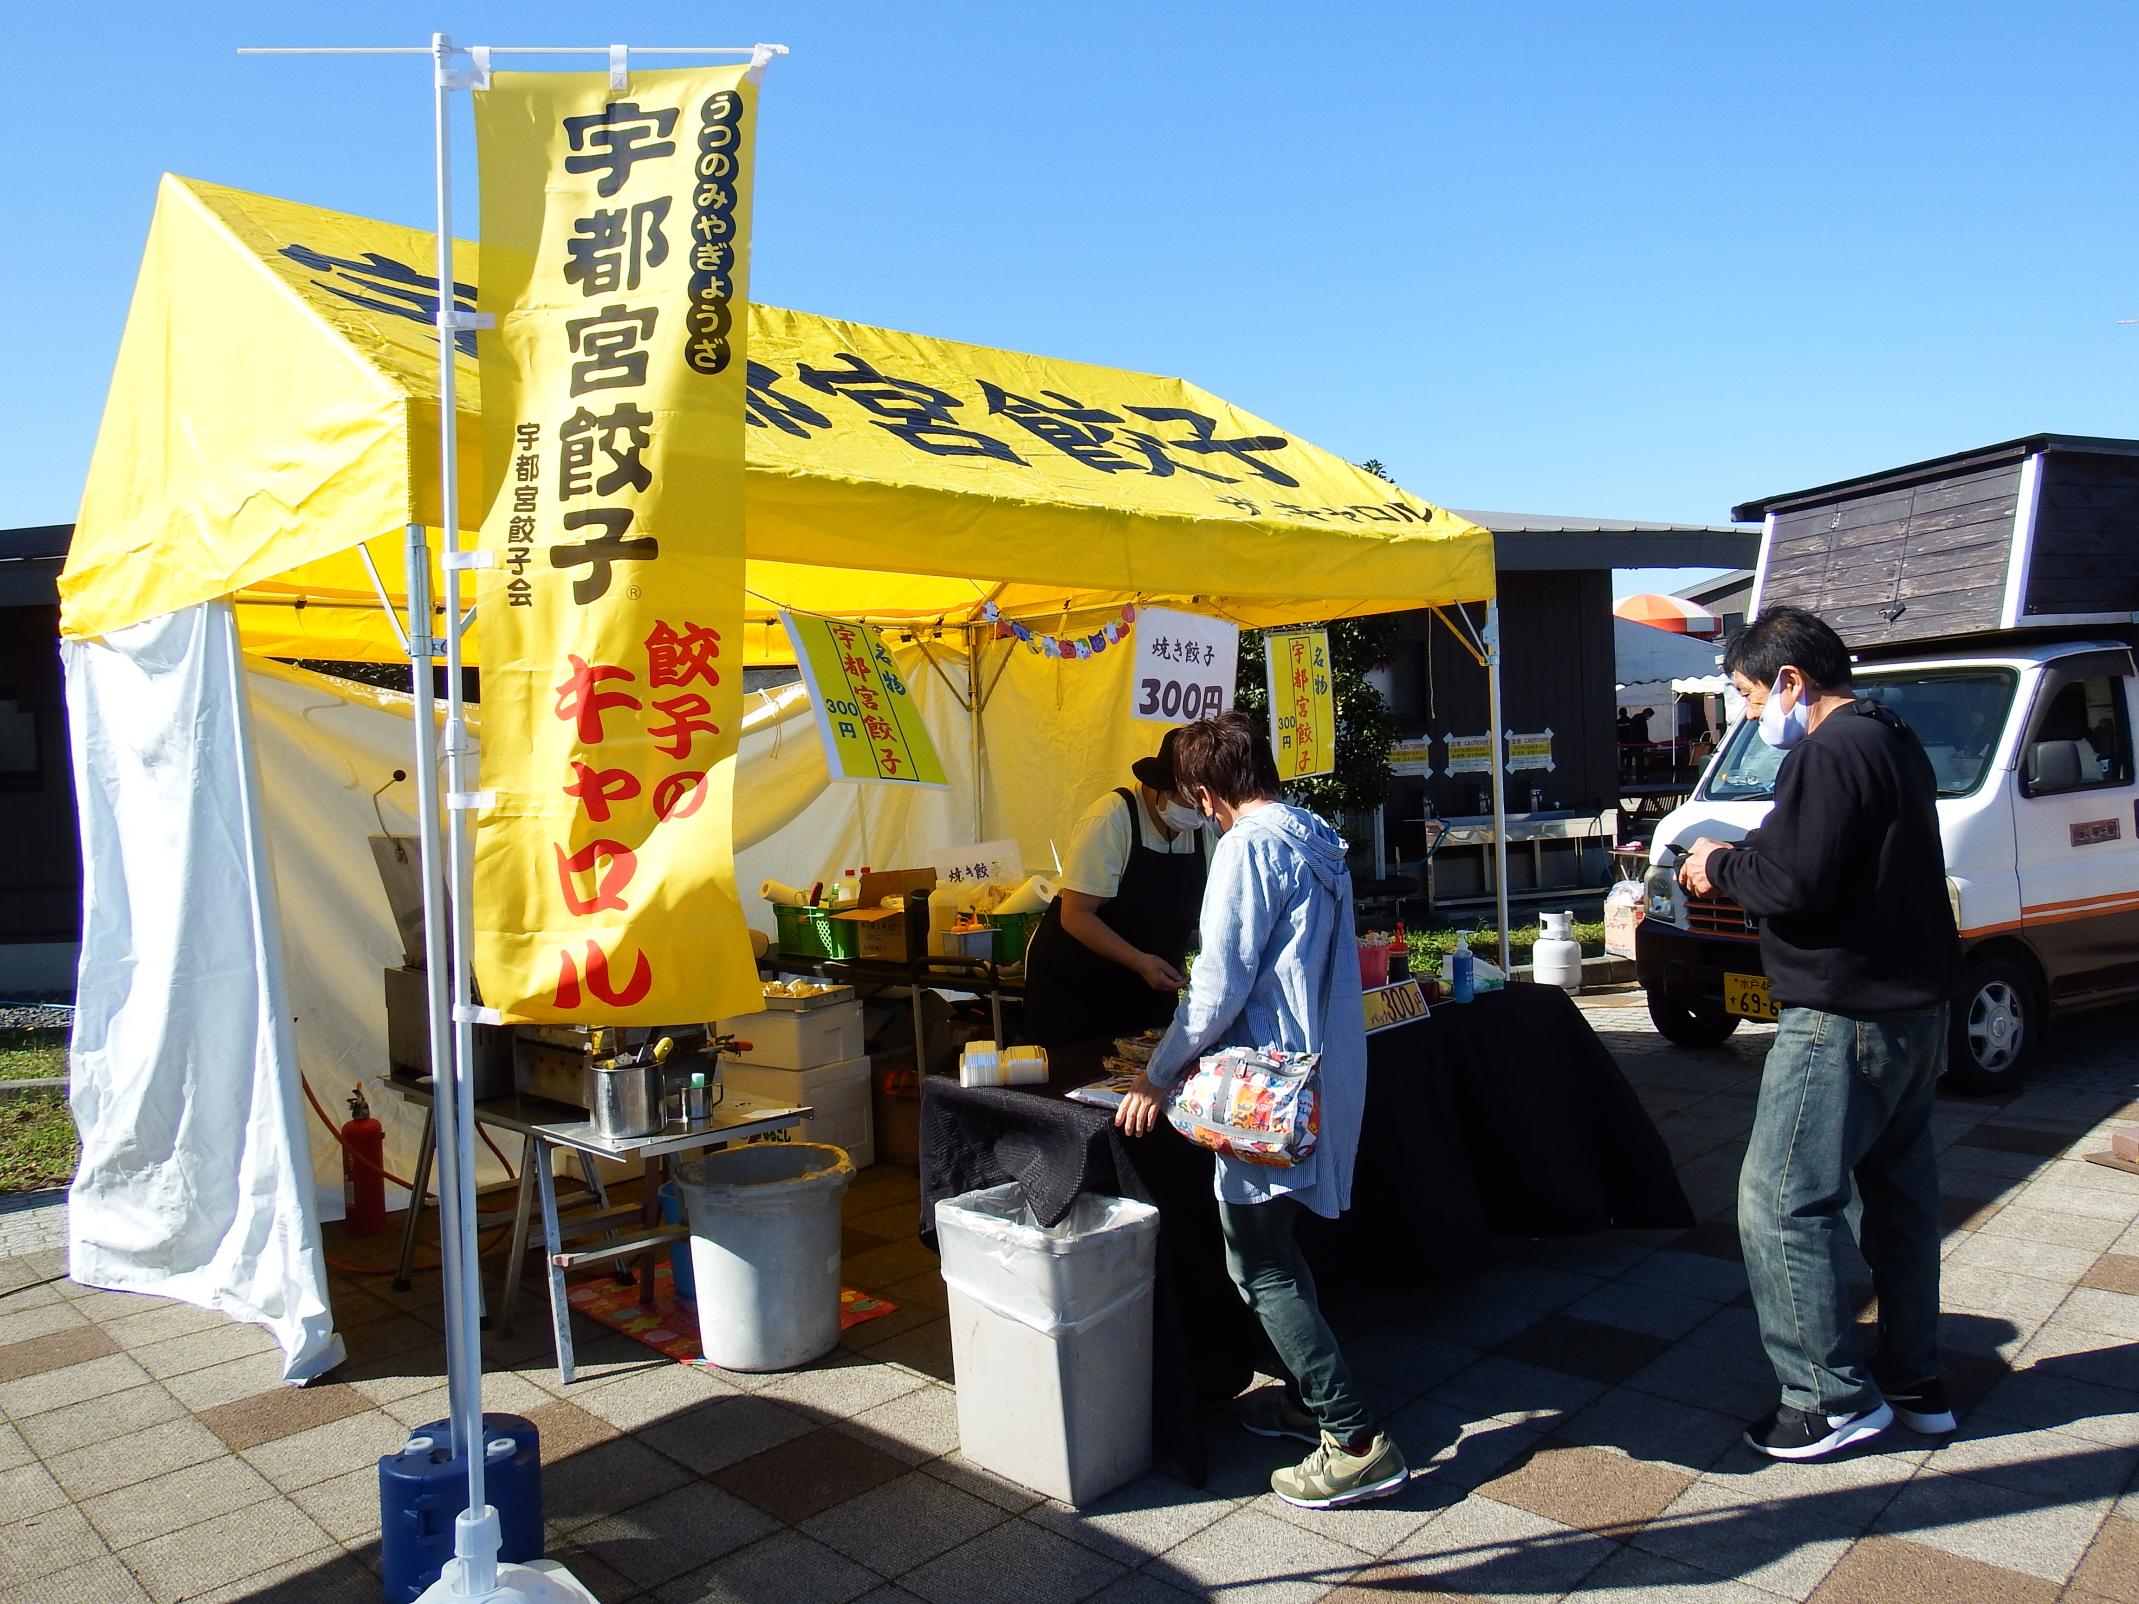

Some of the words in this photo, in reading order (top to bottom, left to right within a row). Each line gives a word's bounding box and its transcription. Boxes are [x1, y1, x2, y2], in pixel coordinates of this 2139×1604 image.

[692, 93, 734, 370] うつのみやぎょうざ
[550, 102, 680, 606] 宇都宮餃子
[506, 421, 541, 608] 宇都宮餃子会
[643, 619, 722, 823] 餃子の
[832, 625, 902, 775] 宇都宮餃子
[875, 643, 907, 696] 名物
[1138, 678, 1223, 721] 300円
[1151, 636, 1215, 667] 焼き餃子
[1291, 640, 1313, 772] 宇都宮餃子
[1313, 646, 1328, 696] 名物
[553, 653, 652, 1009] キャロル
[948, 861, 996, 883] 焼き餃
